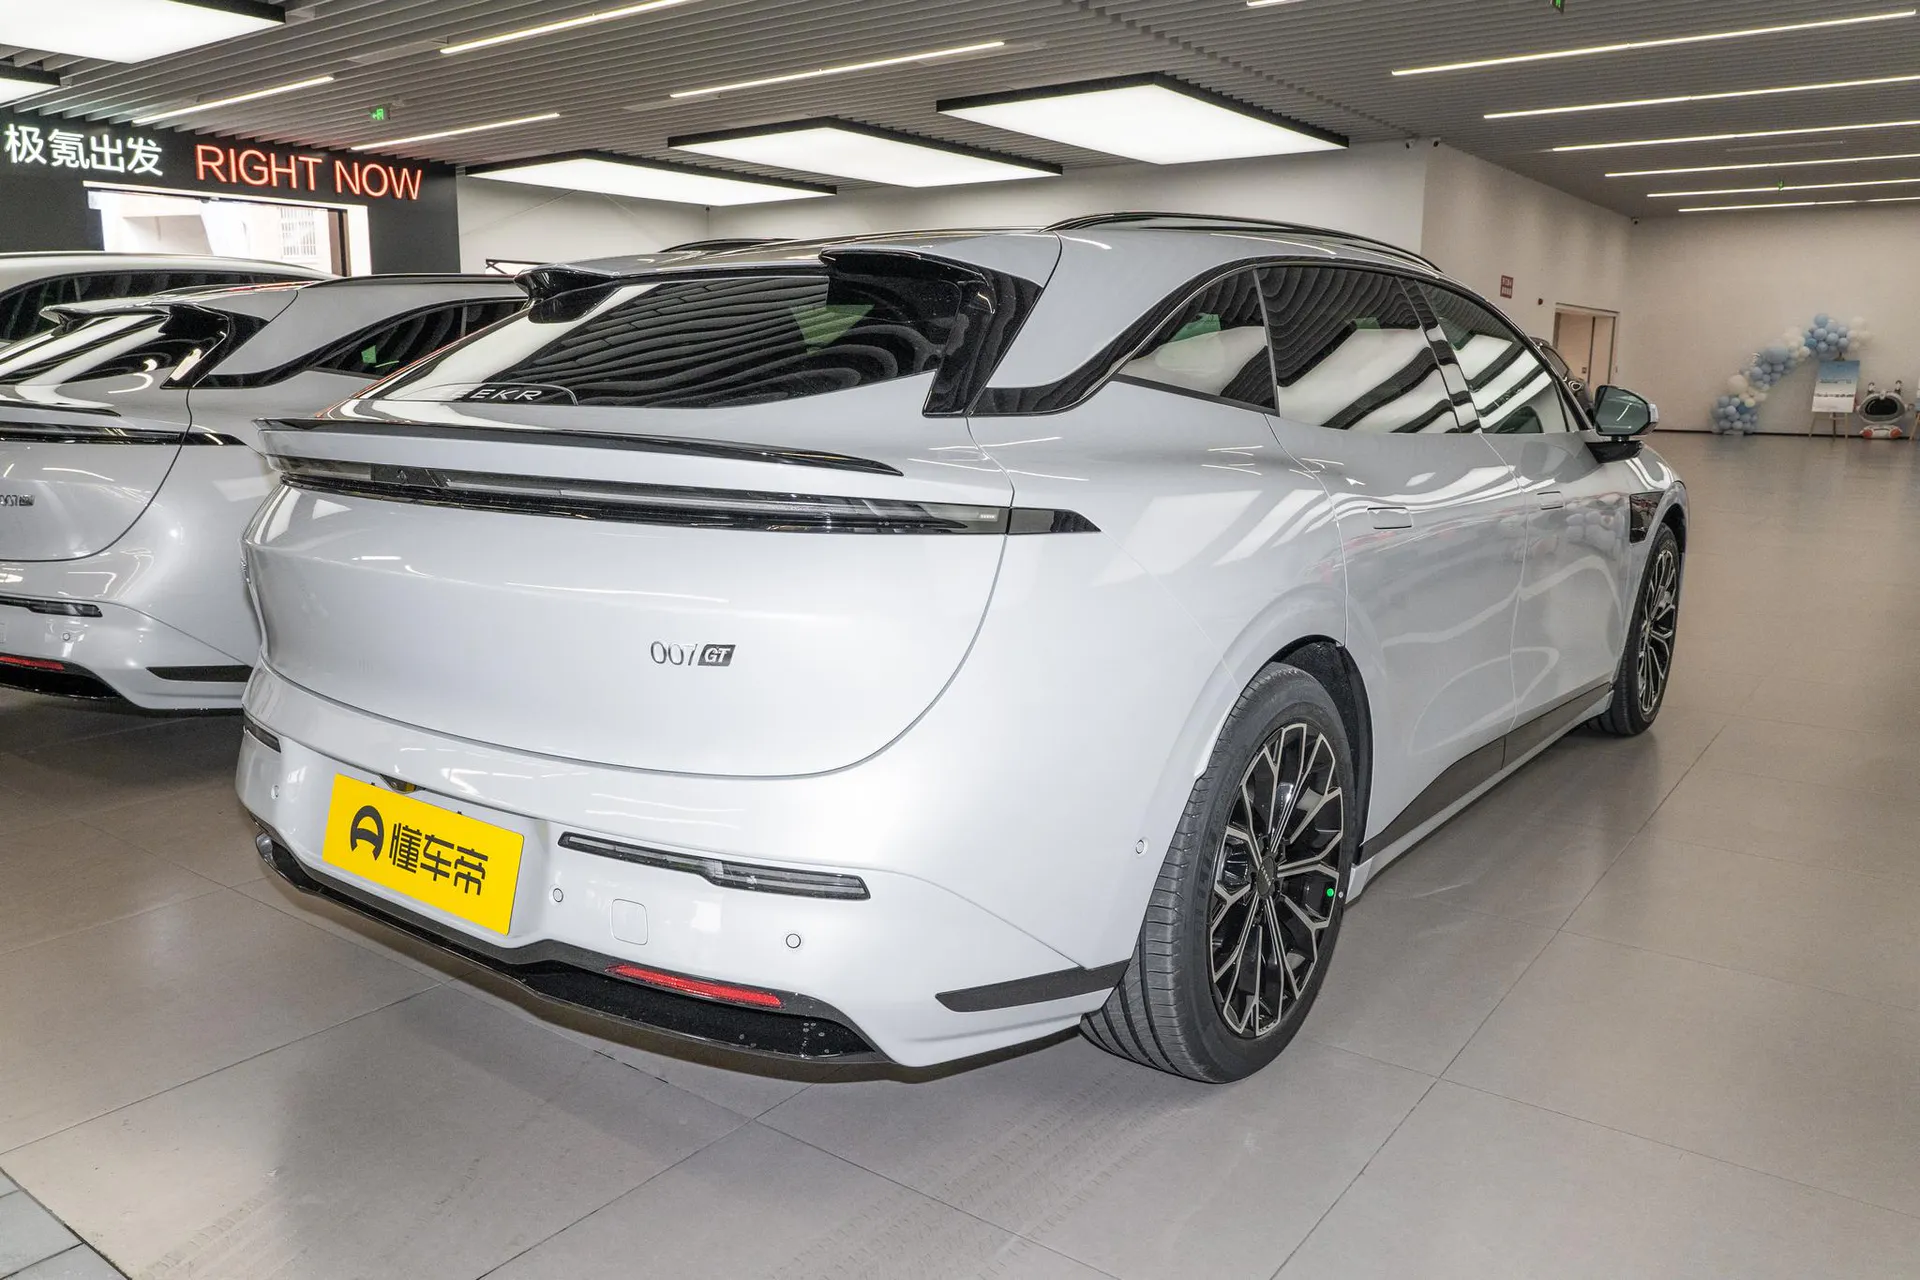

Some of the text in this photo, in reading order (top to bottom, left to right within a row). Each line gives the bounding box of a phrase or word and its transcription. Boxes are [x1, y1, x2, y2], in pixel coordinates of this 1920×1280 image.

[4, 122, 164, 177] 极氪出发
[195, 143, 423, 201] RIGHT NOW
[650, 641, 733, 666] 007 GT
[388, 822, 489, 897] 懂车帝
